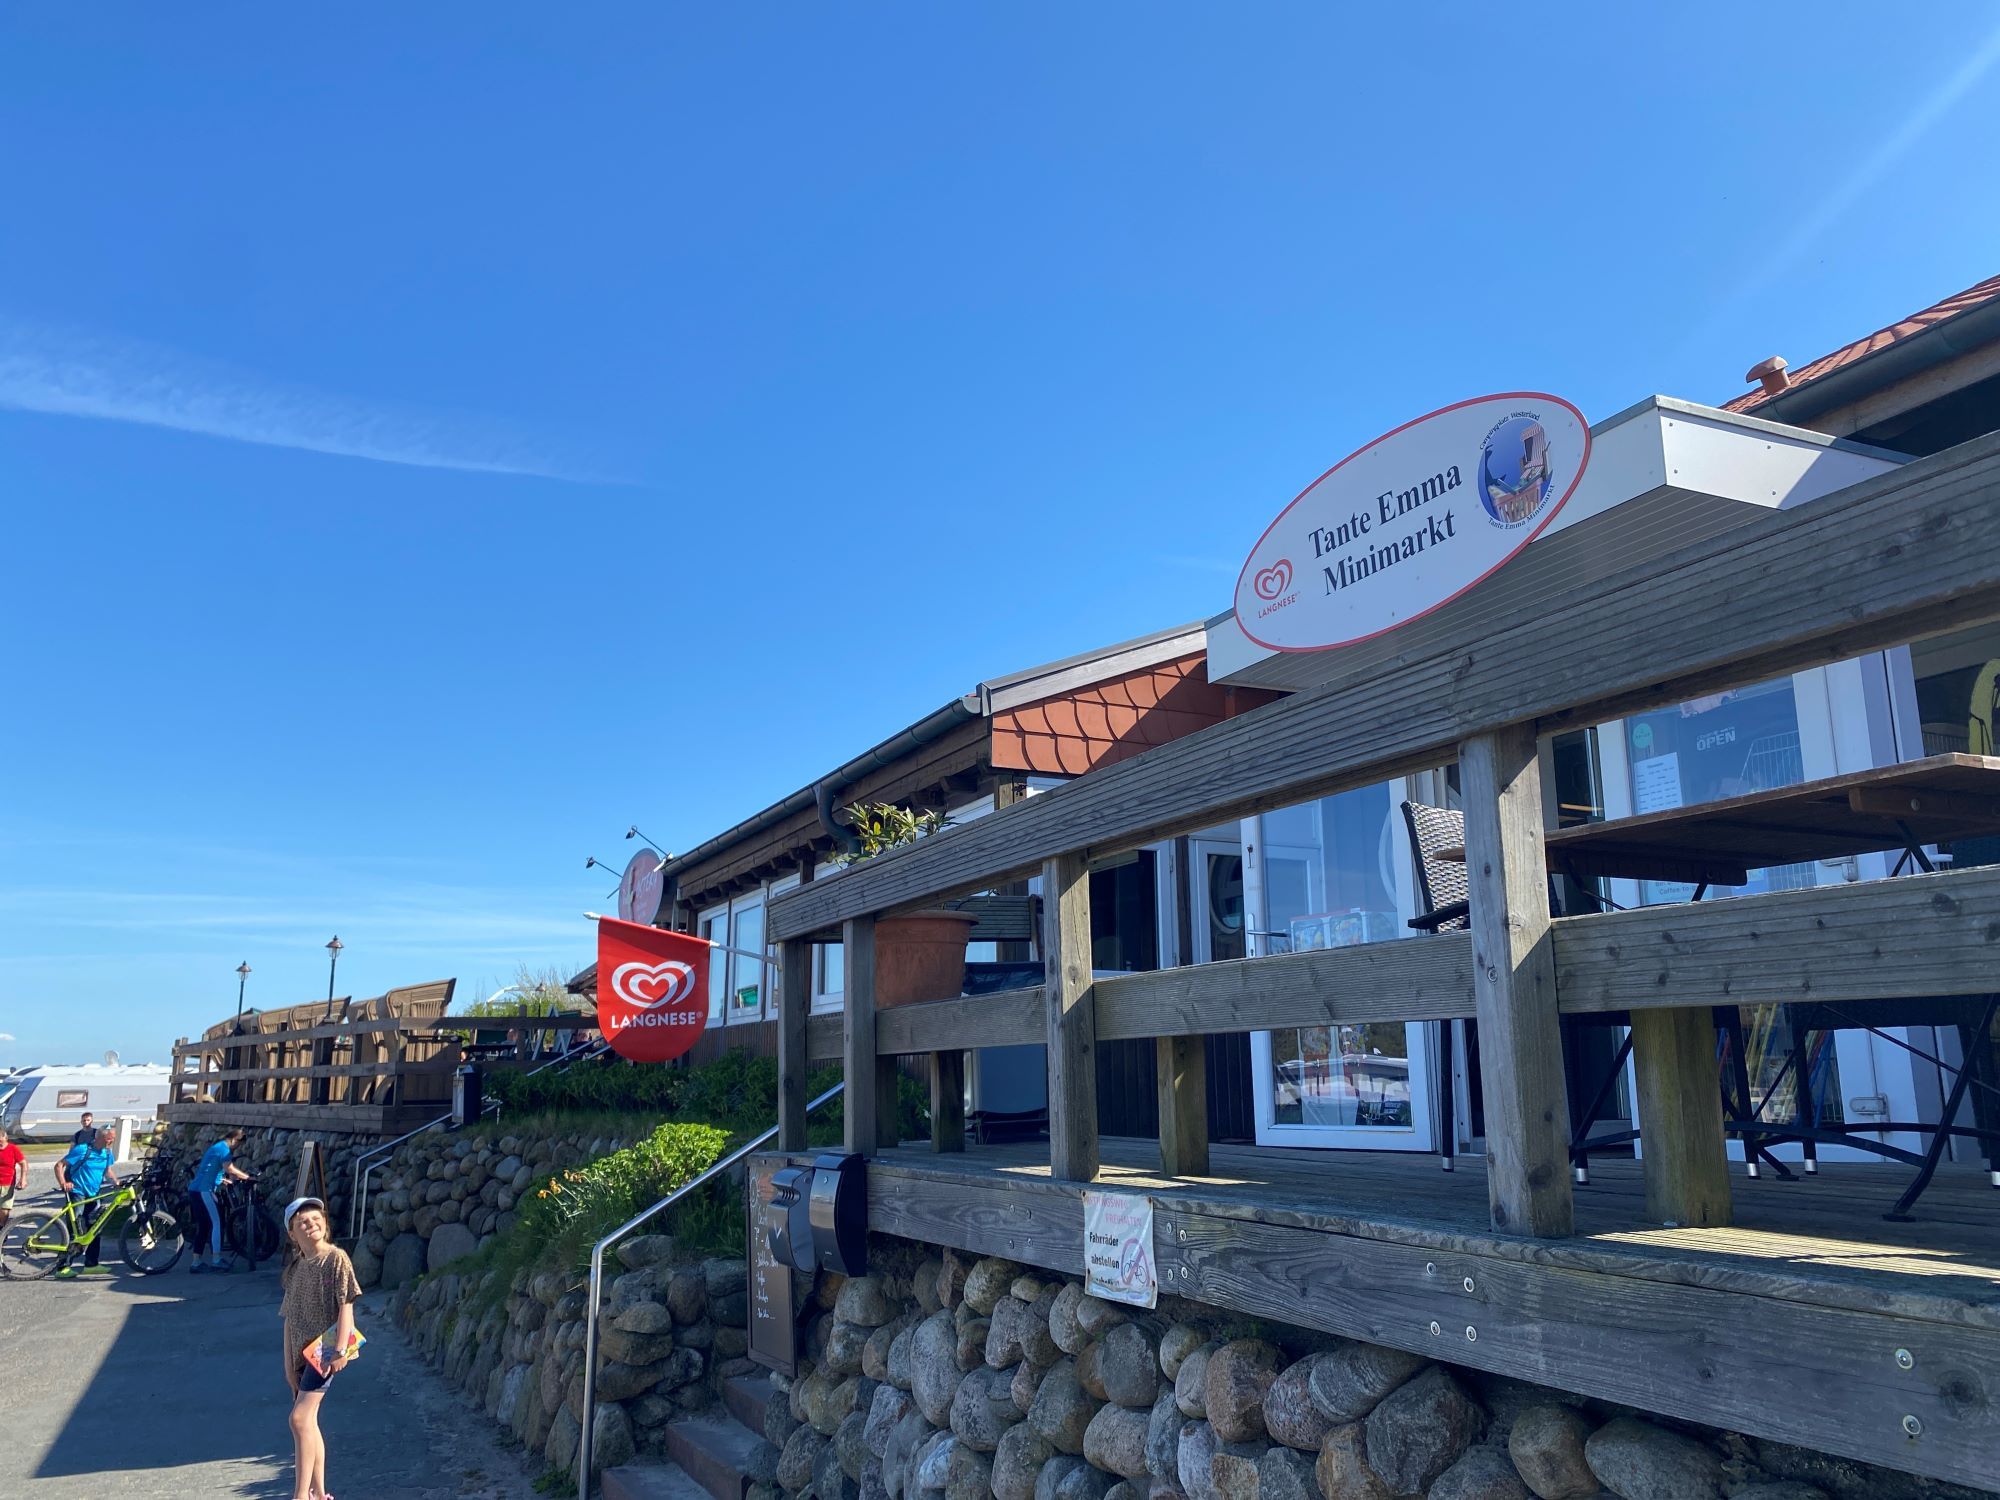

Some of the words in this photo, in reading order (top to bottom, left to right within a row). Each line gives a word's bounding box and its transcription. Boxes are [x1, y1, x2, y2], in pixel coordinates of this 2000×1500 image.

[1510, 411, 1540, 421] Westerland
[1308, 512, 1371, 559] Tante
[1376, 465, 1463, 526] Emma
[1488, 517, 1504, 530] Tante
[1505, 521, 1526, 530] Emma
[1527, 484, 1555, 522] Minimarkt
[1323, 509, 1456, 596] Minimarkt
[1258, 594, 1296, 619] LANGNESE
[1696, 730, 1736, 751] OPEN
[611, 1011, 696, 1029] LANGNESE
[1089, 1231, 1119, 1247] Fahrräder
[1091, 1254, 1120, 1269] abstellen
